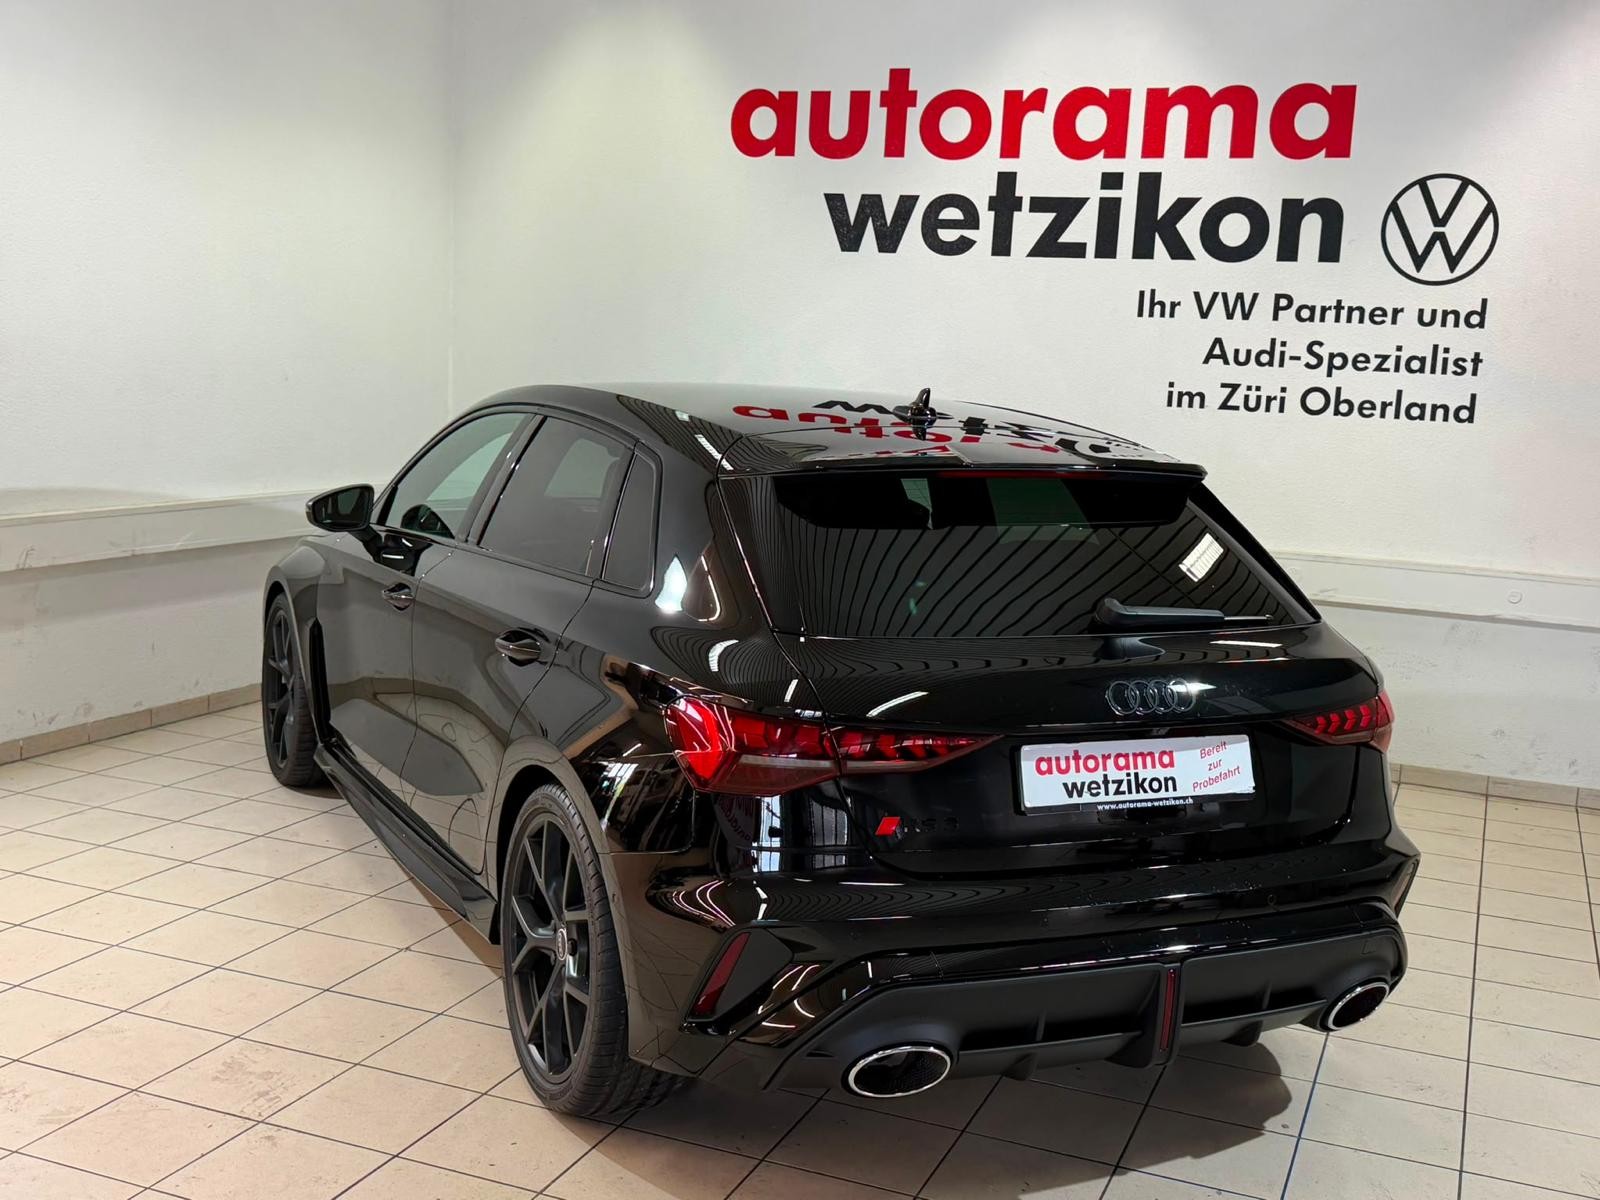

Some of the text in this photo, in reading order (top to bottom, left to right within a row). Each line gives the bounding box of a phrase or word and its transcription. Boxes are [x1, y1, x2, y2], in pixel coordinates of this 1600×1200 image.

[731, 68, 1358, 160] autorama
[823, 172, 1344, 264] wetzikon
[1137, 289, 1488, 329] Ihr VW Partner und
[1202, 337, 1484, 378] Audi-Spezialist
[1166, 381, 1477, 424] im Züri Oberland
[1035, 750, 1176, 776] autorama
[1199, 740, 1228, 759] Bereit
[1192, 765, 1241, 792] Probefahrt
[1207, 759, 1222, 771] zur
[1062, 772, 1178, 798] wetzikon
[1097, 797, 1194, 811] www.autorama-wetzikon.ch
